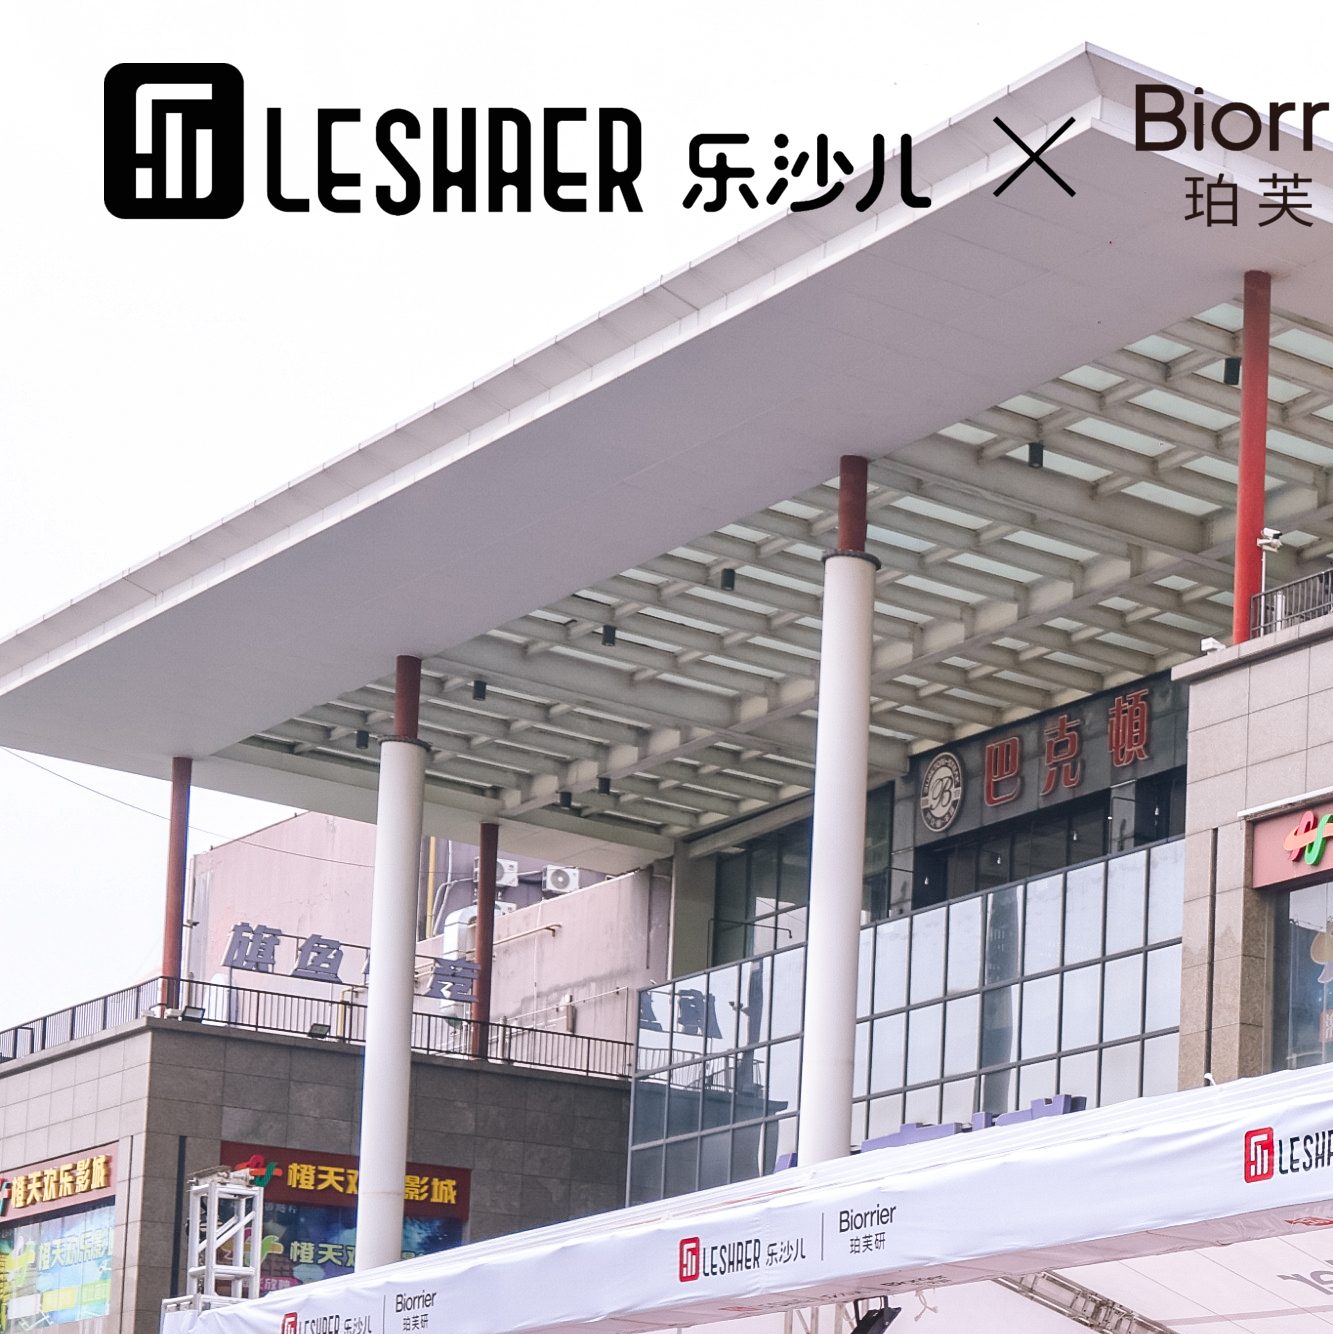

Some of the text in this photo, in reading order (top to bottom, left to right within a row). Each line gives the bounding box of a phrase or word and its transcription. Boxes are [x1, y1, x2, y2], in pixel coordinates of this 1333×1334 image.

[838, 1204, 896, 1233] Biorrier
[766, 1237, 806, 1267] 乐沙儿
[849, 1232, 886, 1255] 珀芙研
[395, 1291, 437, 1315] Biorrier
[402, 1312, 429, 1332] 珀芙研
